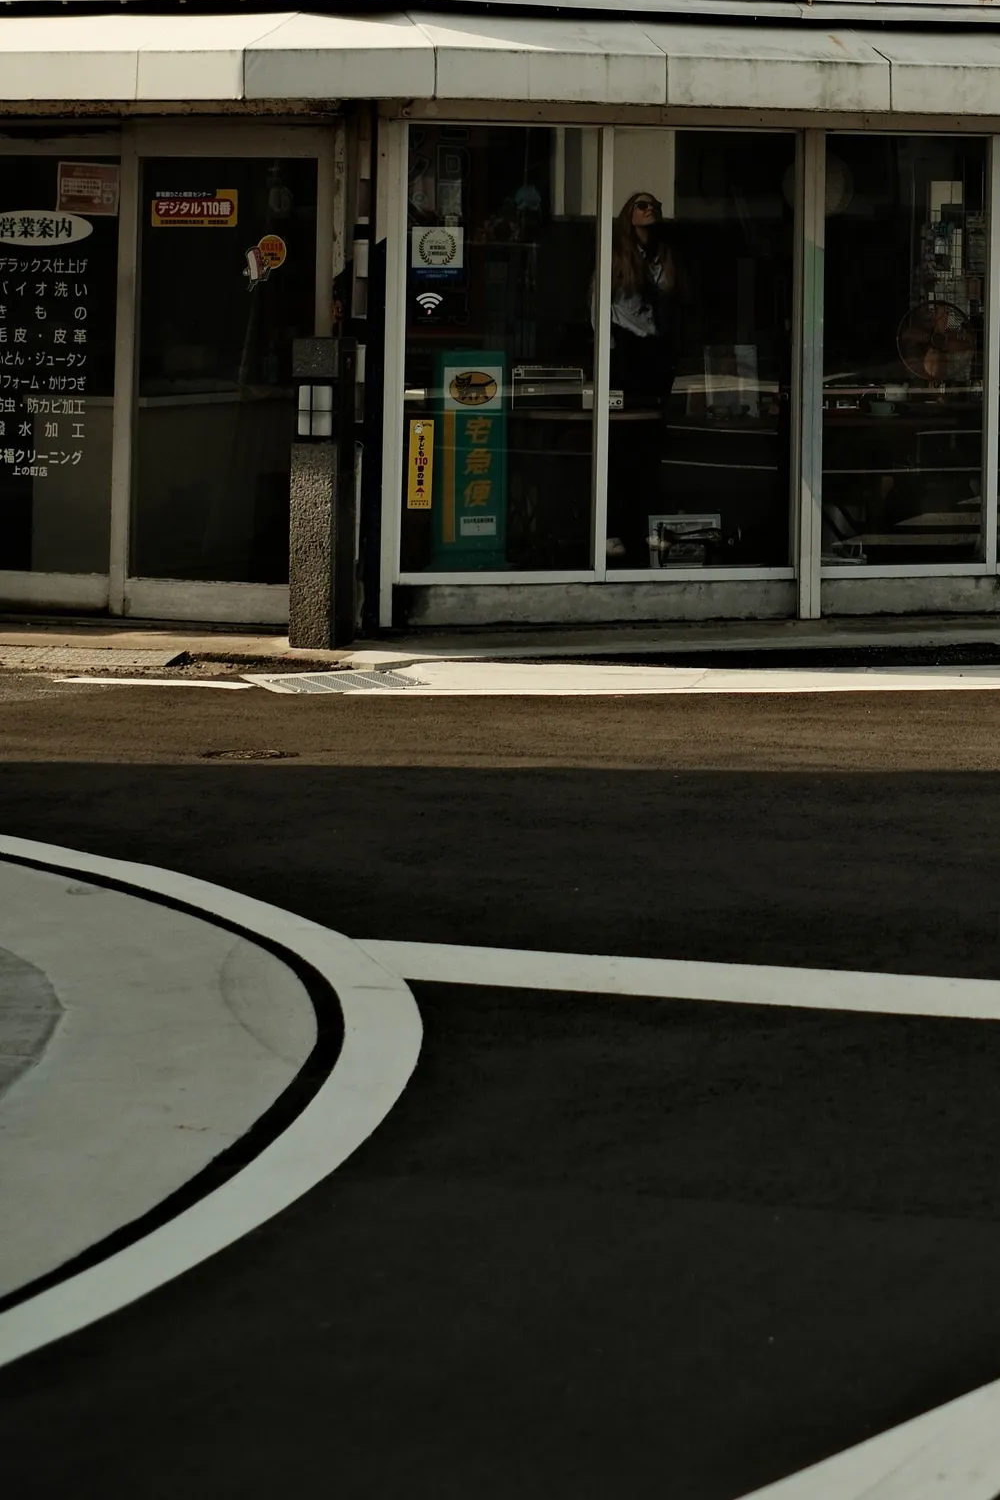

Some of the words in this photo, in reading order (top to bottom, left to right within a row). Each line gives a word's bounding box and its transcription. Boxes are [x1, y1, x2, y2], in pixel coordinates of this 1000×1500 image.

[158, 201, 231, 216] デジタル110番
[0, 217, 72, 238] 営業案内
[0, 350, 87, 367] とん・ジュータン
[0, 375, 86, 391] フォーム・かけつぎ
[0, 448, 83, 465] 福クリーニング
[464, 417, 494, 508] 宅急便
[12, 466, 48, 477] 上の町店
